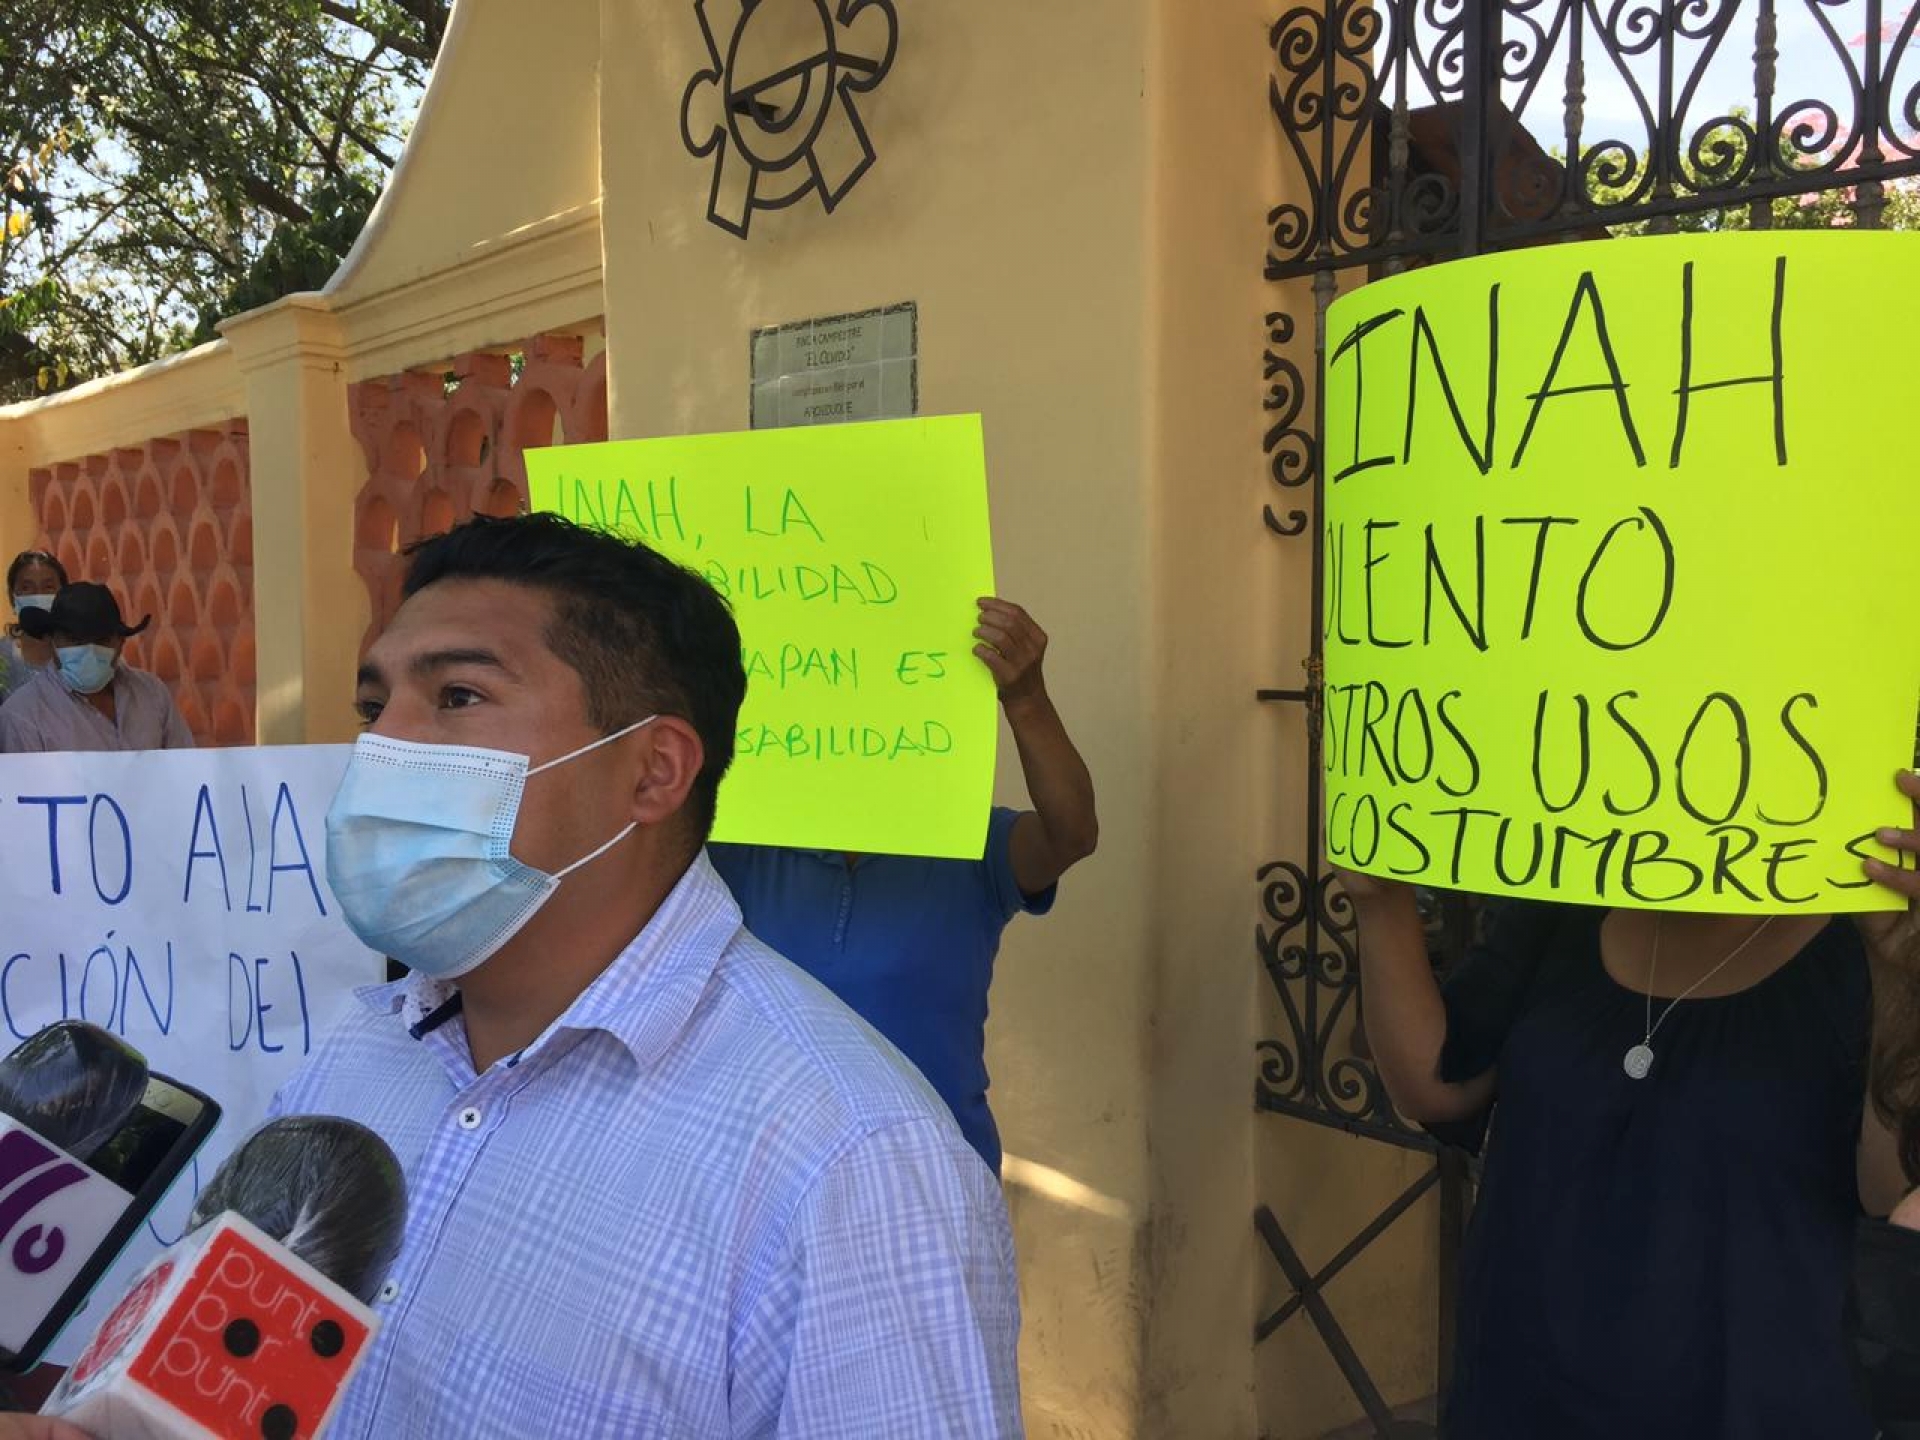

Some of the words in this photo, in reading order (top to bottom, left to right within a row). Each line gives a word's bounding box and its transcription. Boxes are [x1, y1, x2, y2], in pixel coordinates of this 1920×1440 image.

[1329, 255, 1787, 484] INAH
[745, 484, 826, 543] LA
[740, 643, 858, 690] APAN
[895, 650, 948, 685] ES
[1531, 688, 1829, 827] USOS
[1, 929, 174, 1041] CIÓN
